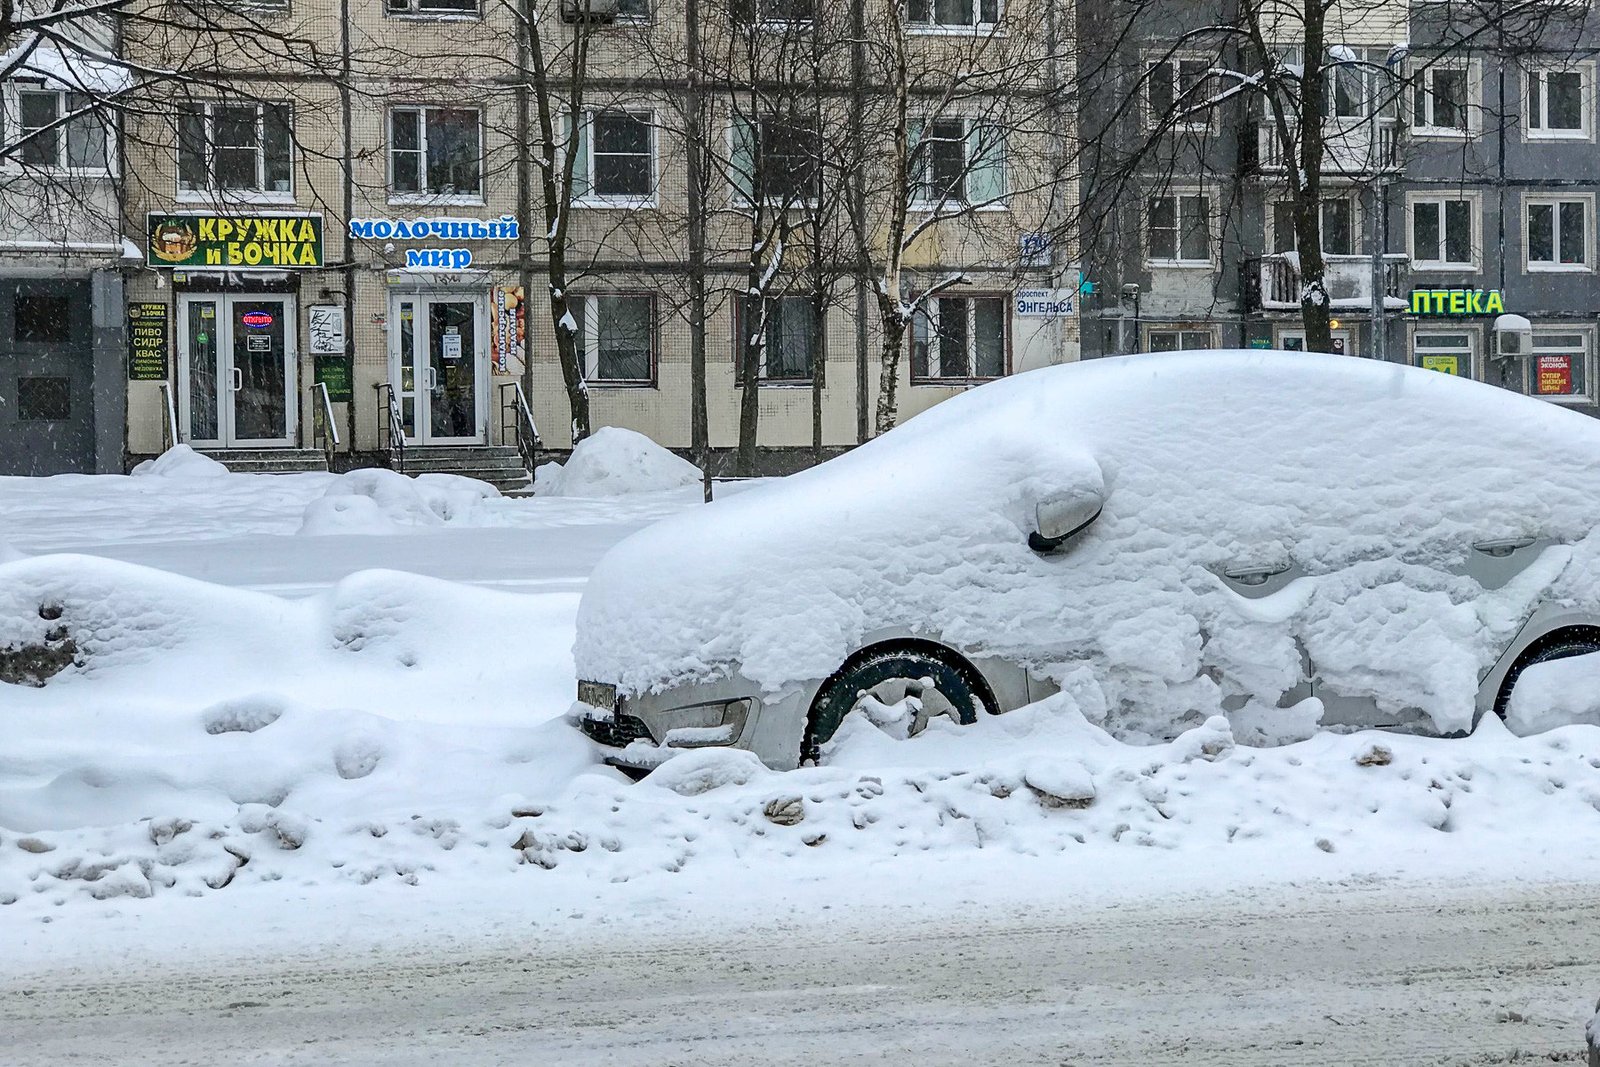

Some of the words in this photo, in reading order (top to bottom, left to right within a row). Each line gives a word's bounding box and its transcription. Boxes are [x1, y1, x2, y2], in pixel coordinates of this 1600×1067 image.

[199, 218, 316, 242] КРУЖКА
[350, 216, 519, 238] молочный
[206, 248, 221, 265] и
[227, 241, 317, 266] БОЧКА
[407, 250, 472, 269] мир
[1018, 291, 1048, 299] проспект
[1017, 301, 1073, 313] ЭНГЕЛЬСА
[1404, 290, 1505, 314] ПТЕКА
[243, 316, 273, 324] ОТКРЫТО
[134, 328, 162, 336] ПИВО
[133, 338, 163, 347] СИДР
[135, 349, 162, 358] КВАС
